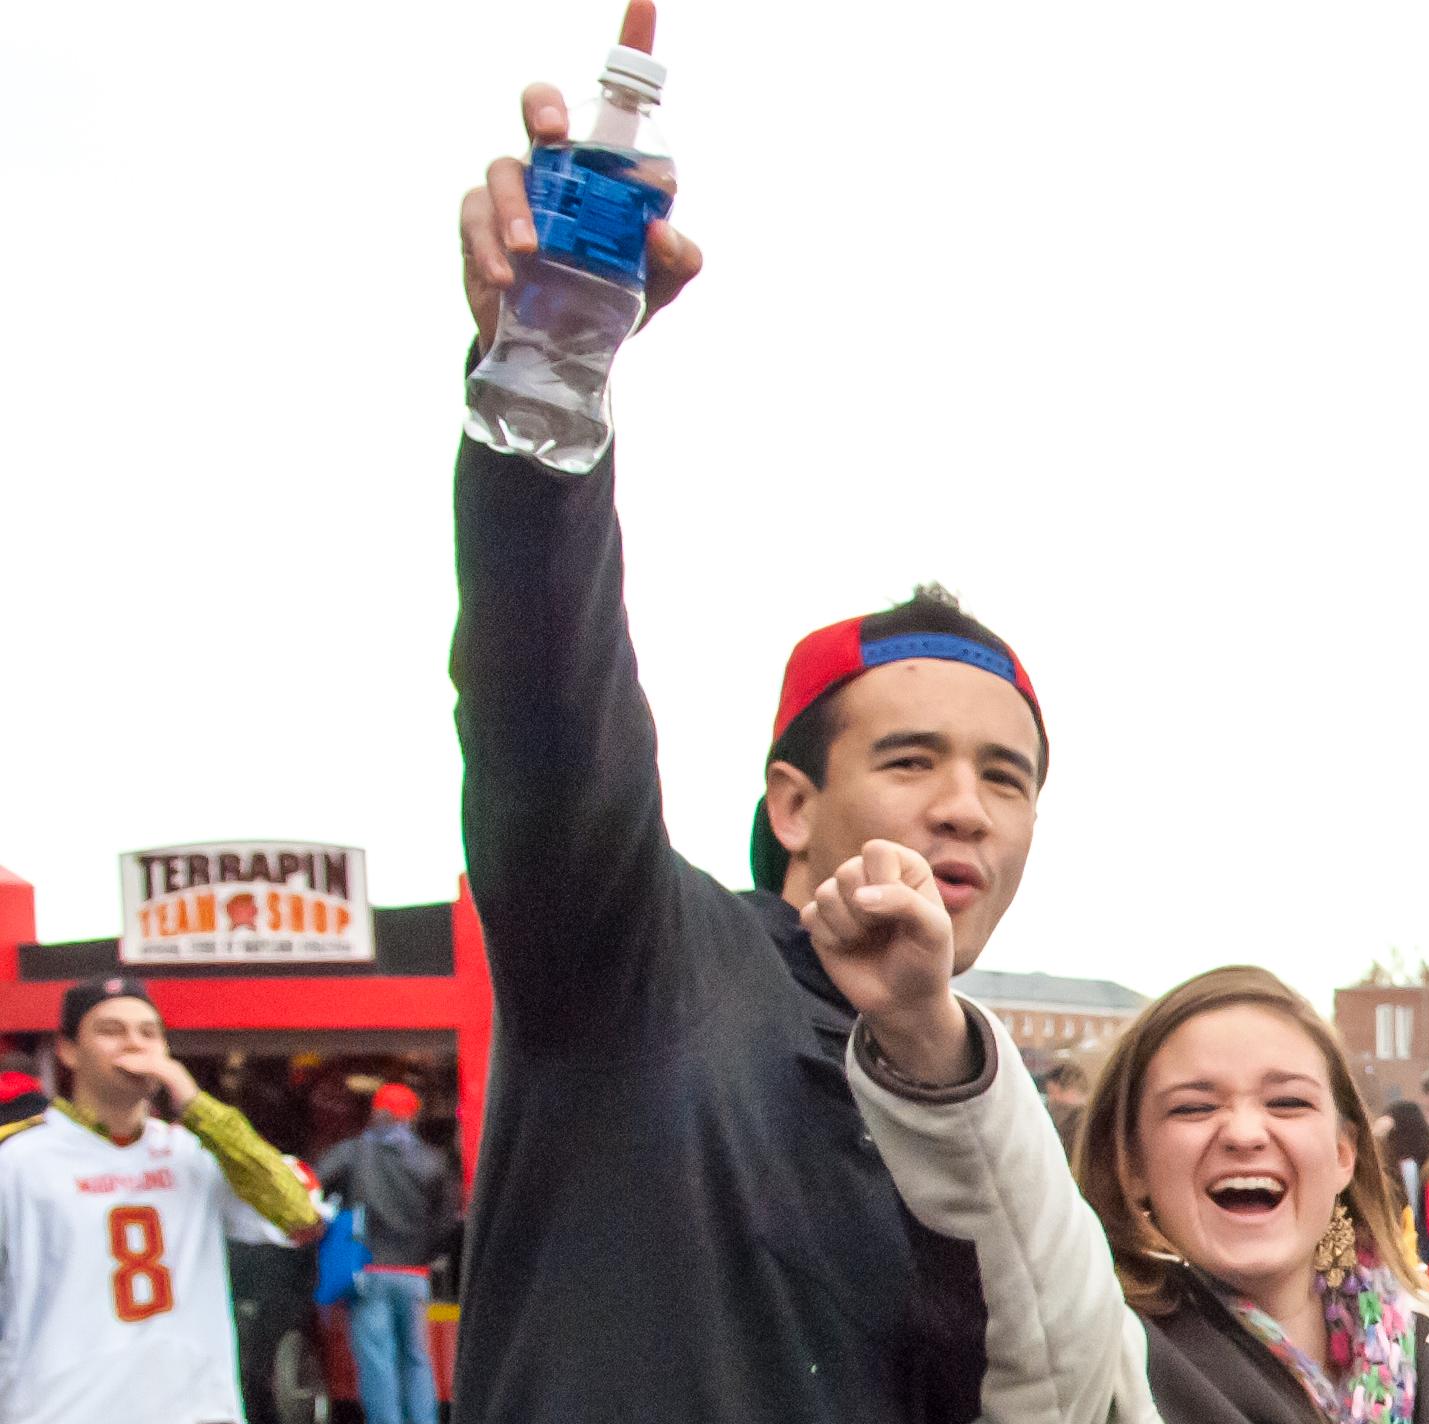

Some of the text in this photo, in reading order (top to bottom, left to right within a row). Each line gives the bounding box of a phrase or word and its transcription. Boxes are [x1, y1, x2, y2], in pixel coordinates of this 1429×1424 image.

[138, 852, 348, 901] TERRAPIN
[138, 891, 350, 938] TEAM SHOP
[107, 1204, 174, 1323] 8
